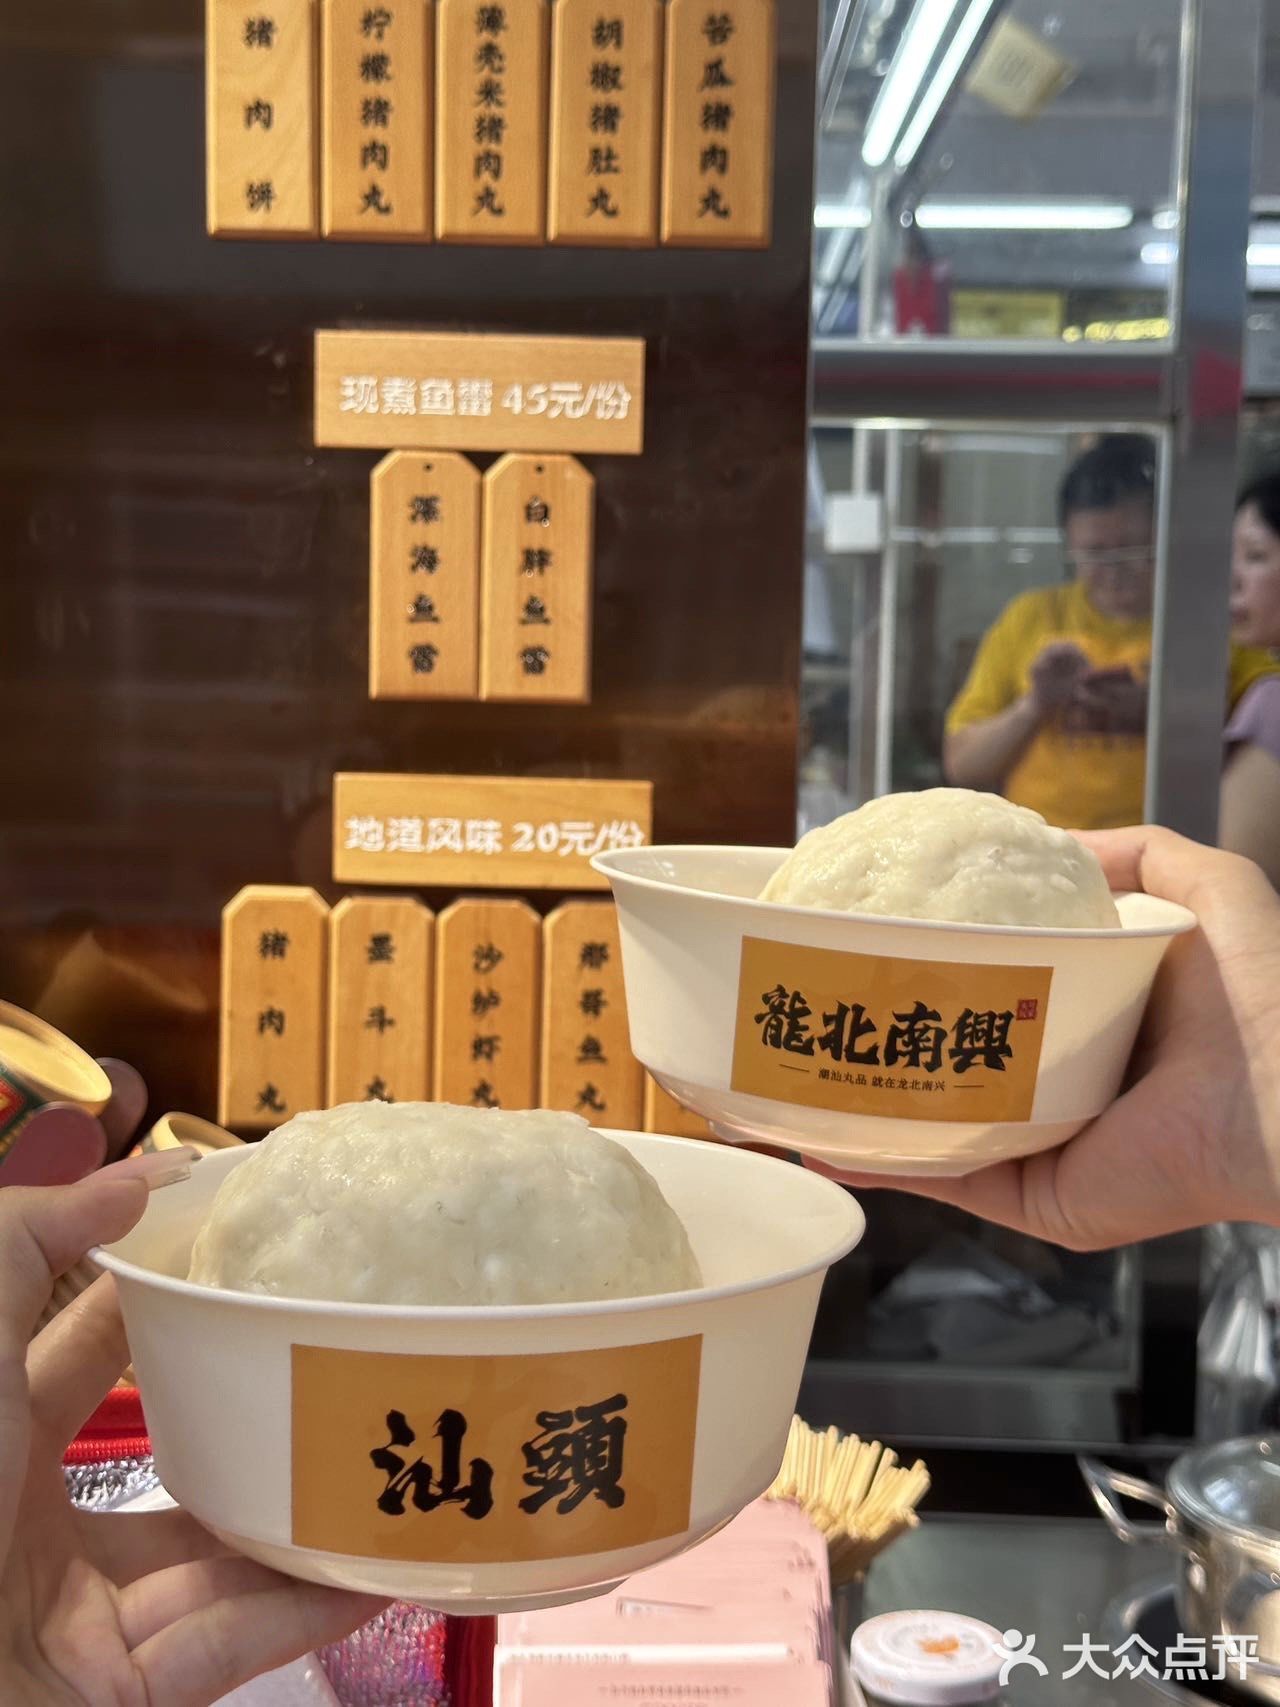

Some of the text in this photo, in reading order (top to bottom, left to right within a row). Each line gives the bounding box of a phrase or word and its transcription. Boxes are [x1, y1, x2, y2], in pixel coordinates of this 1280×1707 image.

[243, 17, 278, 212] 猪肉饼
[360, 8, 394, 217] 柠檬猪肉丸
[587, 17, 624, 219] 胡椒猪肚丸
[697, 13, 735, 220] 苦瓜猪肉丸
[501, 380, 632, 420] 45元/份
[343, 816, 503, 855] 地道风味
[256, 930, 290, 1113] 猪肉丸
[753, 983, 1016, 1074] 龍北南興
[817, 1067, 946, 1092] 潮汕丸品 就在龙北南兴
[369, 1393, 629, 1521] 汕頭
